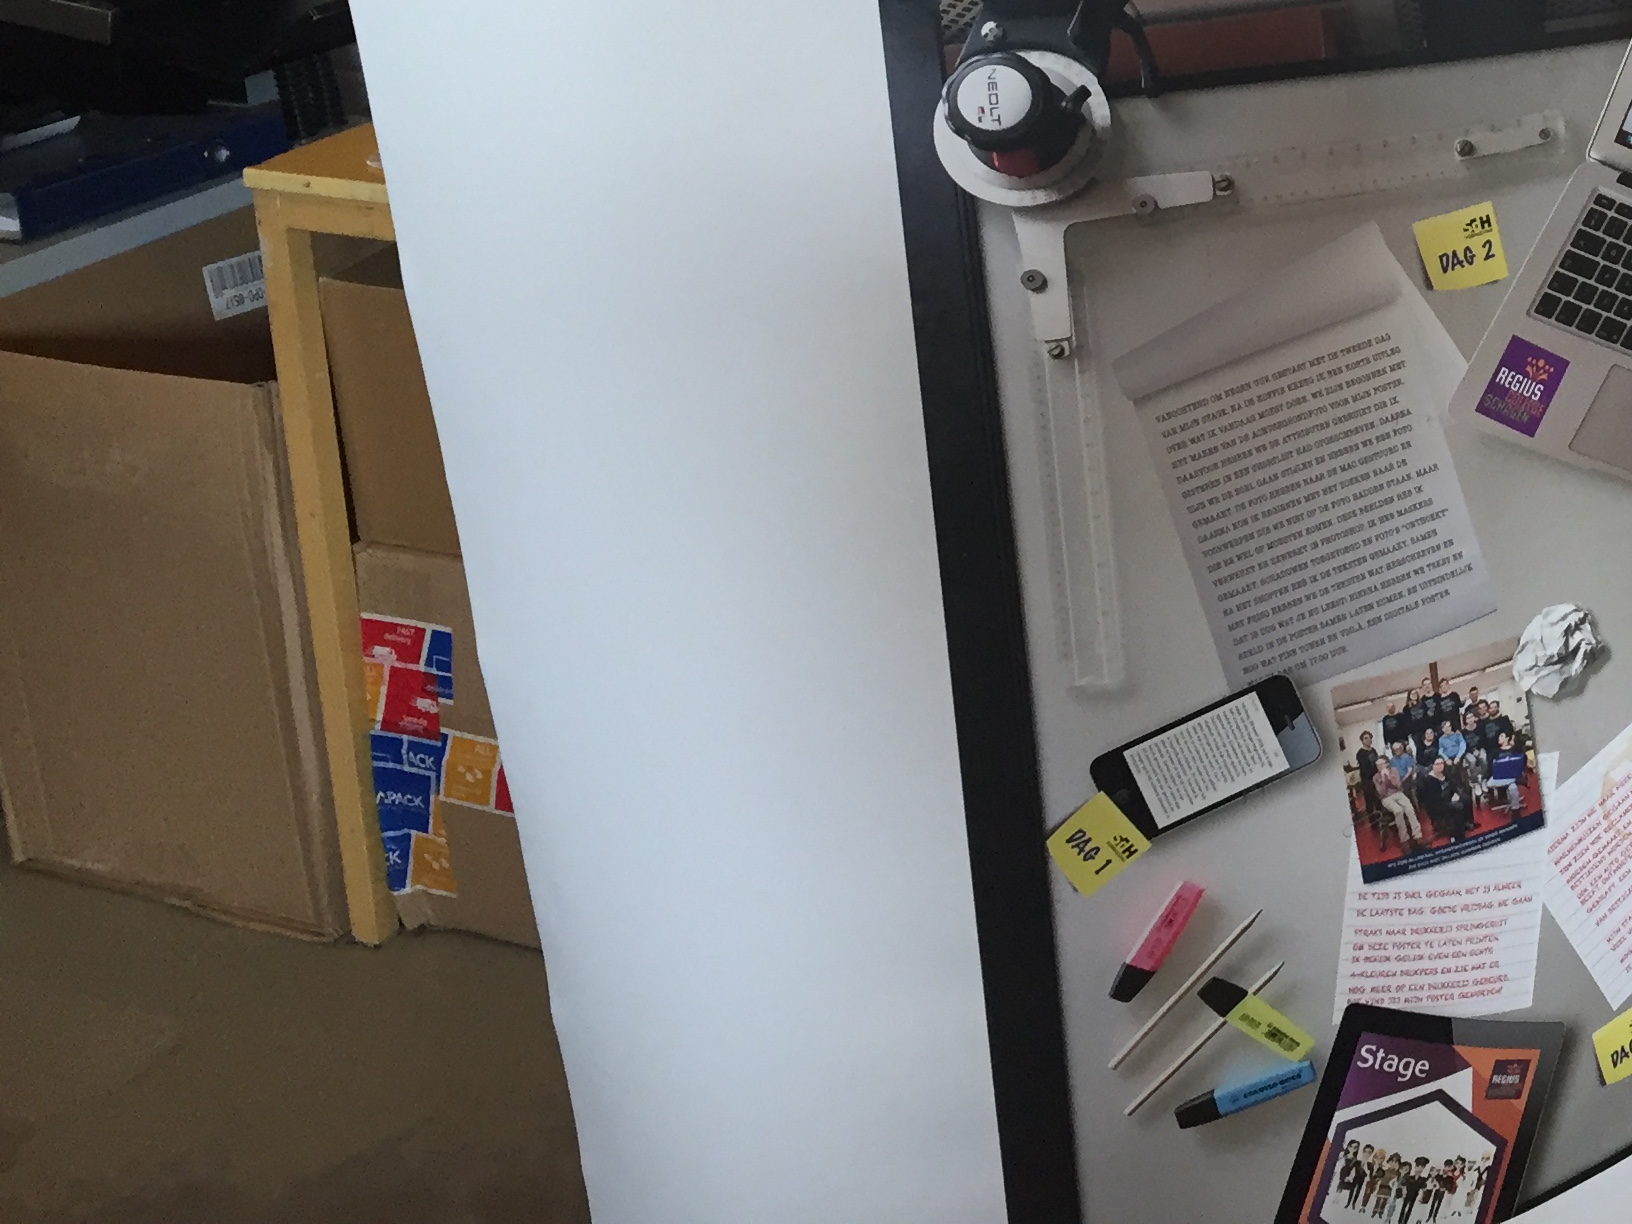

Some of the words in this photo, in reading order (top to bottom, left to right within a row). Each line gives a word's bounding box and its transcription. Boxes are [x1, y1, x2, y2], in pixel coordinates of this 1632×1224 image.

[984, 67, 1003, 126] NEOLT
[1438, 247, 1477, 275] DAG
[1482, 239, 1496, 262] 2
[1495, 366, 1545, 402] REGIUS
[1483, 393, 1531, 424] SCHAGEN
[1065, 827, 1101, 862] DAG
[1094, 858, 1113, 876] 1
[1356, 1044, 1431, 1083] Stage
